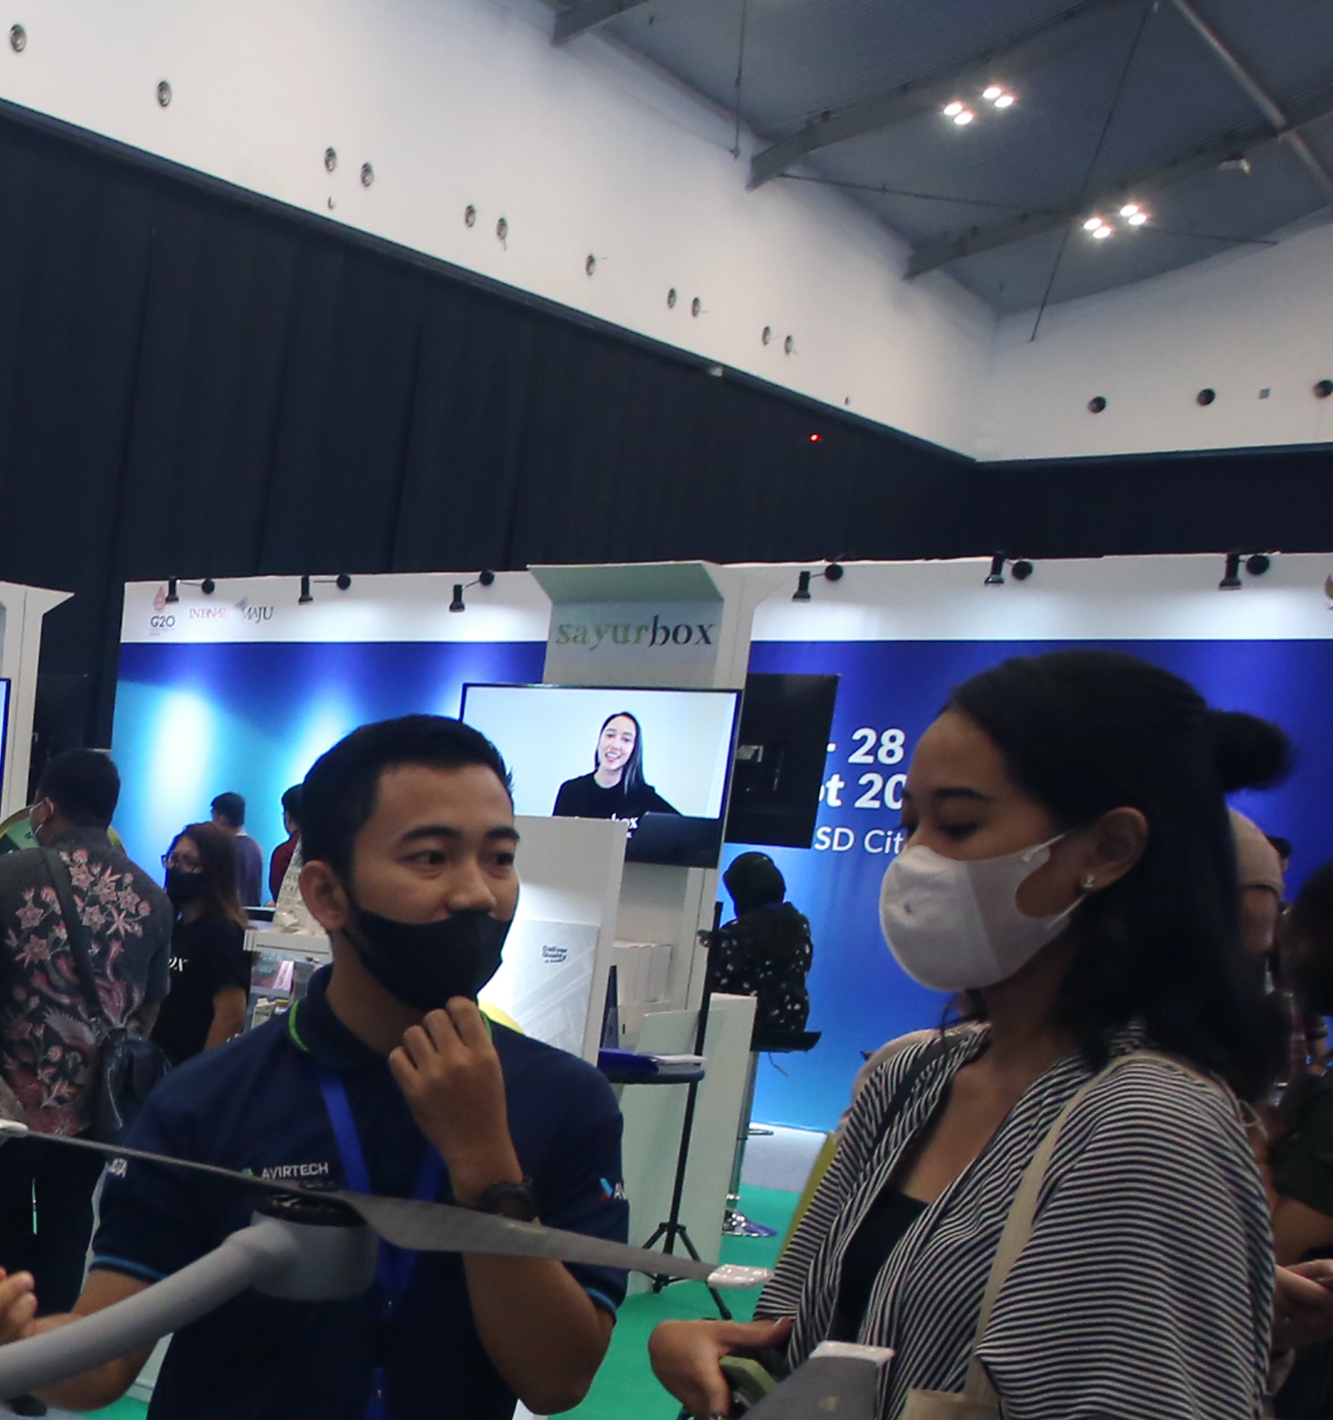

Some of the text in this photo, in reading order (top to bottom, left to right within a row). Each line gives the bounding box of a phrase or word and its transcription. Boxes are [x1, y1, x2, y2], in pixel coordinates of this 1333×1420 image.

[150, 615, 176, 628] G20
[556, 614, 716, 651] sayurbox
[847, 727, 906, 765] 28
[261, 1162, 329, 1180] AVIRTECH
